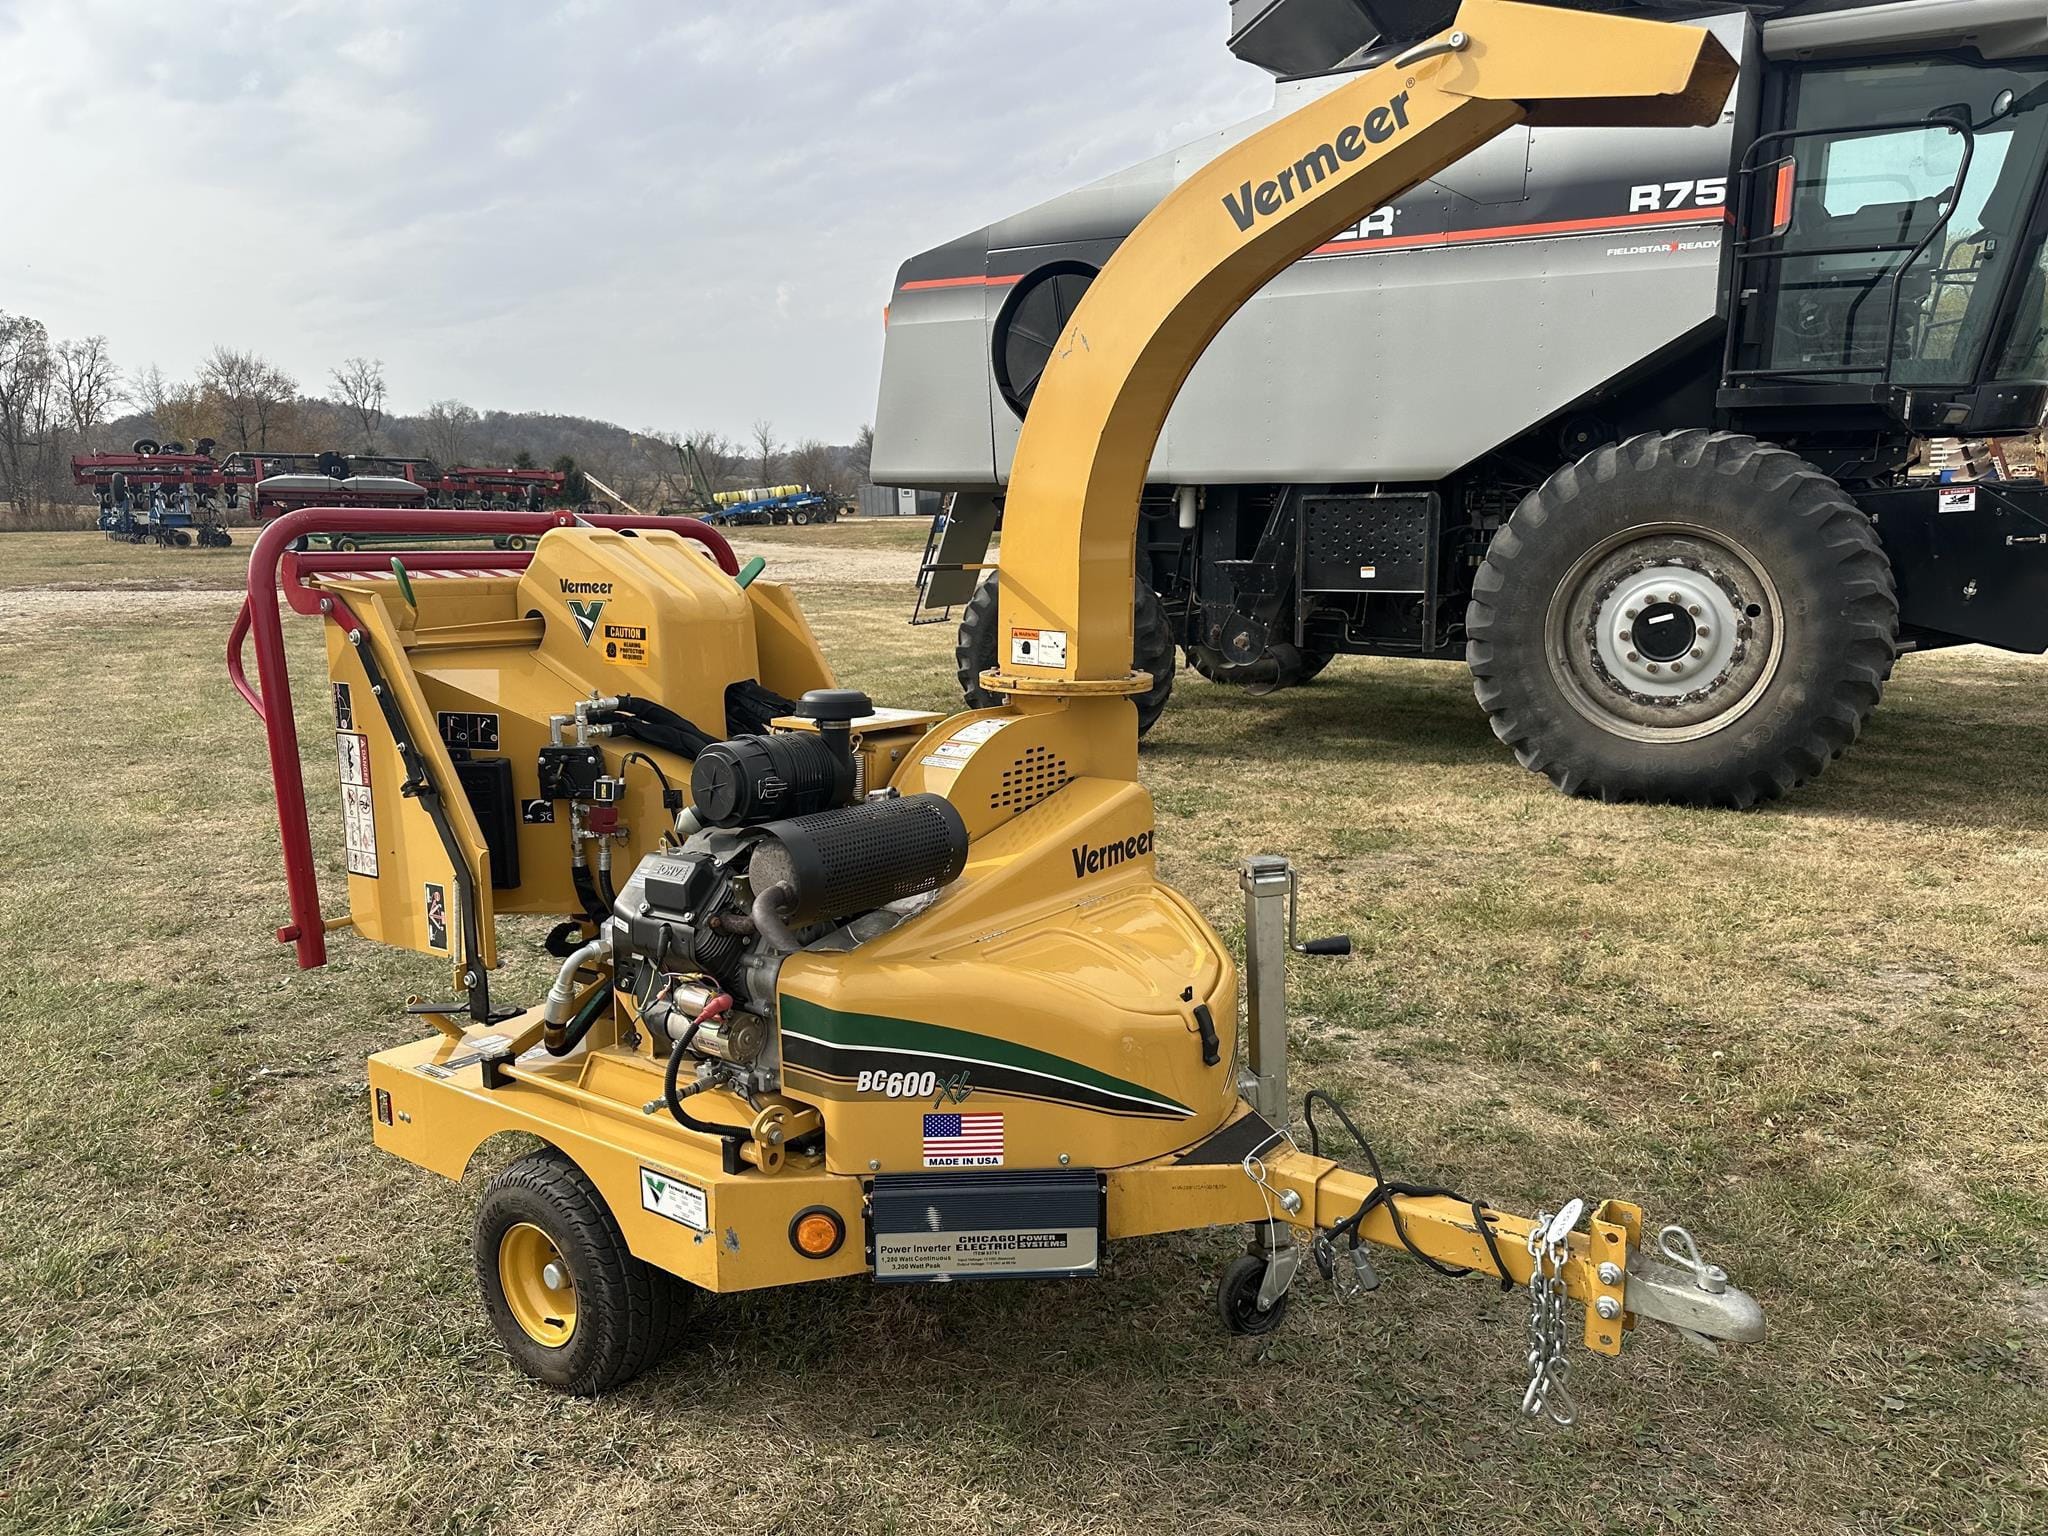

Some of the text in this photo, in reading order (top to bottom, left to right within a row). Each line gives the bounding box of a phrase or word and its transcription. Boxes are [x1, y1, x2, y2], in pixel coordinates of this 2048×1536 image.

[1221, 89, 1410, 233] Vermeer
[1629, 177, 1728, 212] R75
[1606, 240, 1721, 256] FIELDSTAR READY
[560, 578, 613, 594] Vermeer
[610, 627, 641, 640] CAUTION
[361, 749, 369, 785] DANGER
[1072, 829, 1154, 878] Vermeer
[929, 1157, 999, 1166] MADE IN USA
[958, 1235, 1016, 1243] CHICAGO
[1019, 1240, 1066, 1248] SYSTEMS
[880, 1244, 951, 1254] Power Inverter
[955, 1242, 1016, 1251] ELECTRIC
